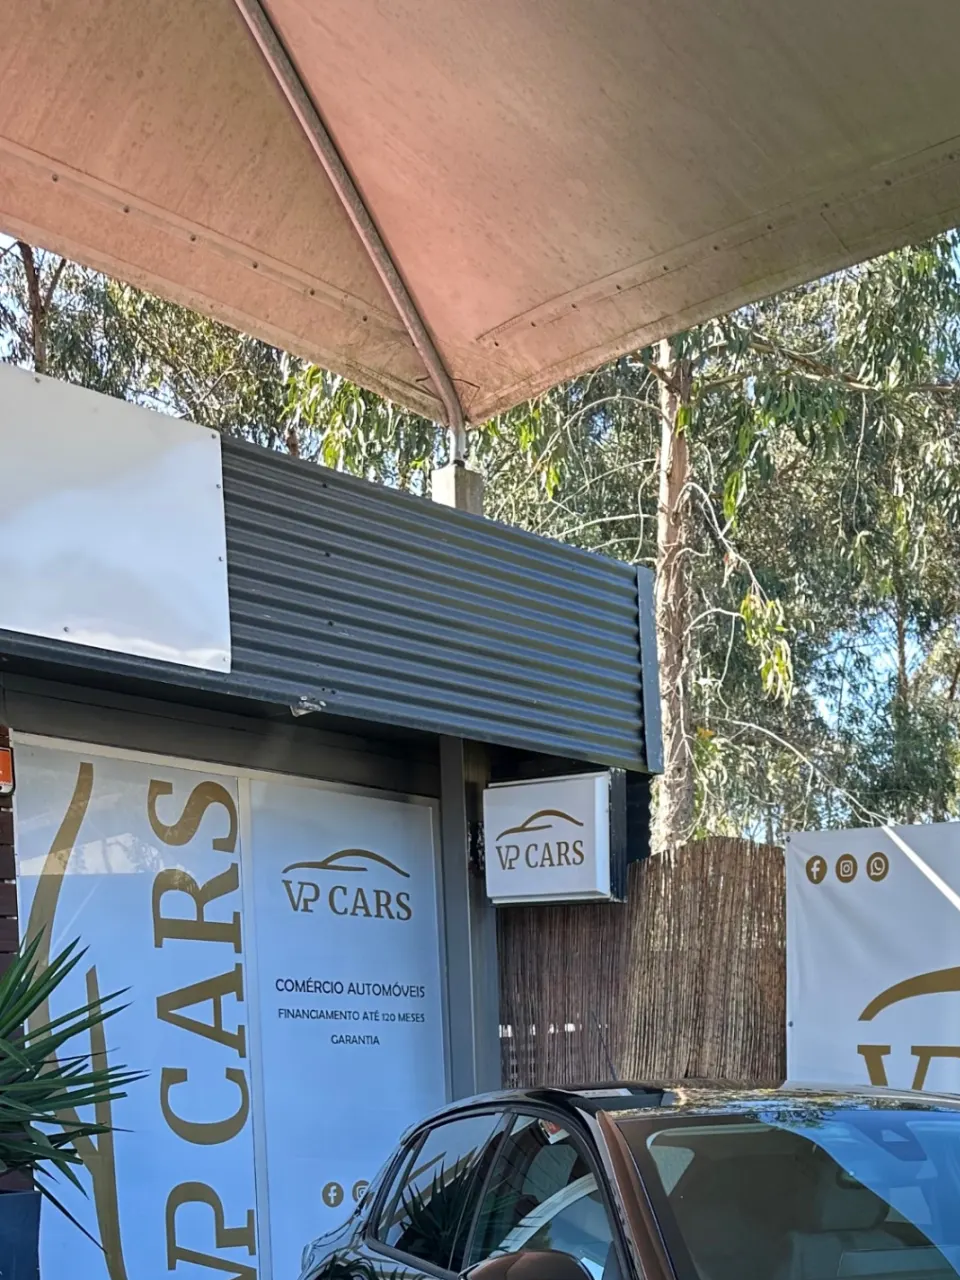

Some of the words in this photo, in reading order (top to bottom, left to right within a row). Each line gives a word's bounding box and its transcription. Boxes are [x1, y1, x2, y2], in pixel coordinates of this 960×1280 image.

[495, 844, 520, 871] VP
[525, 839, 585, 869] CARS
[281, 879, 320, 913] VP
[328, 885, 412, 921] CARS
[147, 779, 251, 1146] CARS
[275, 977, 344, 995] COMÉRCIO
[347, 982, 425, 998] AUTOMÓVEIS
[278, 1008, 360, 1021] FINANCIAMENTO
[362, 1010, 380, 1022] ATÉ
[382, 1013, 396, 1022] 120
[398, 1012, 425, 1023] MESES
[330, 1034, 380, 1046] GARANTIA
